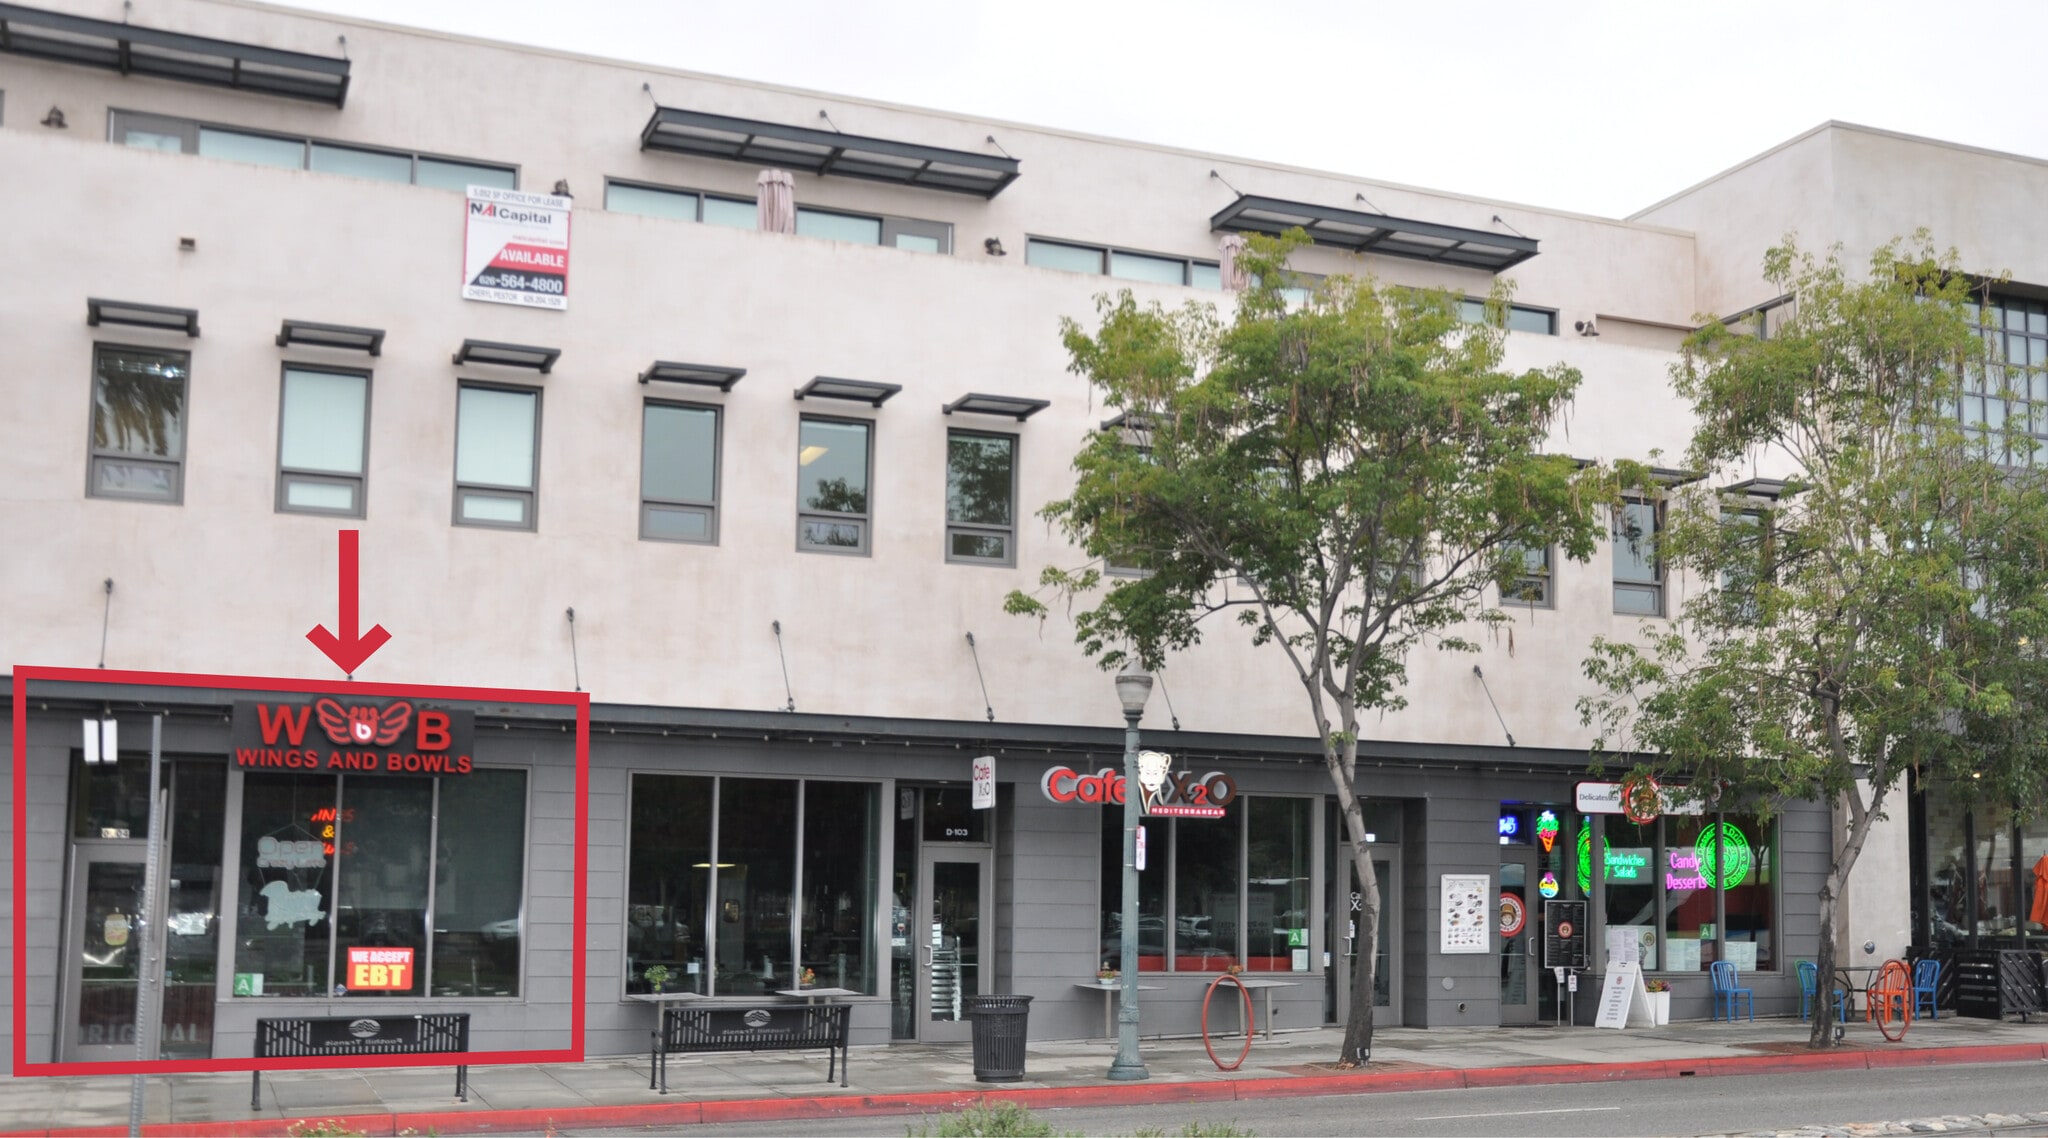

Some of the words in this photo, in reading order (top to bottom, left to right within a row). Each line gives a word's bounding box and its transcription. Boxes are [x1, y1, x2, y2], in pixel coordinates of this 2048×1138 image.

[502, 191, 526, 204] OFFICE
[527, 196, 542, 206] FOR
[543, 198, 564, 208] LEASE
[470, 202, 497, 217] NAI
[499, 207, 552, 224] Capital
[499, 248, 565, 268] AVAILABLE
[478, 273, 563, 293] 626-564-4800
[256, 704, 312, 746] W
[416, 710, 451, 750] B
[236, 747, 319, 769] WINGS
[327, 751, 378, 770] AND
[387, 753, 472, 774] BOWLS
[974, 764, 990, 781] Cafe
[1043, 767, 1126, 804] Cafe
[1165, 771, 1236, 806] X2O
[1151, 806, 1226, 816] MEDITERRANEAN
[322, 824, 335, 838] &
[946, 828, 968, 836] D-103
[1604, 852, 1646, 867] Sandwiches
[1670, 852, 1701, 872] Candy
[1614, 866, 1638, 879] Salads
[1666, 873, 1708, 890] Desserts
[1290, 931, 1301, 943] A
[1701, 927, 1709, 937] A
[351, 951, 369, 963] WE
[370, 951, 411, 963] ACCEPT
[354, 964, 406, 987] EBT
[237, 979, 250, 991] A
